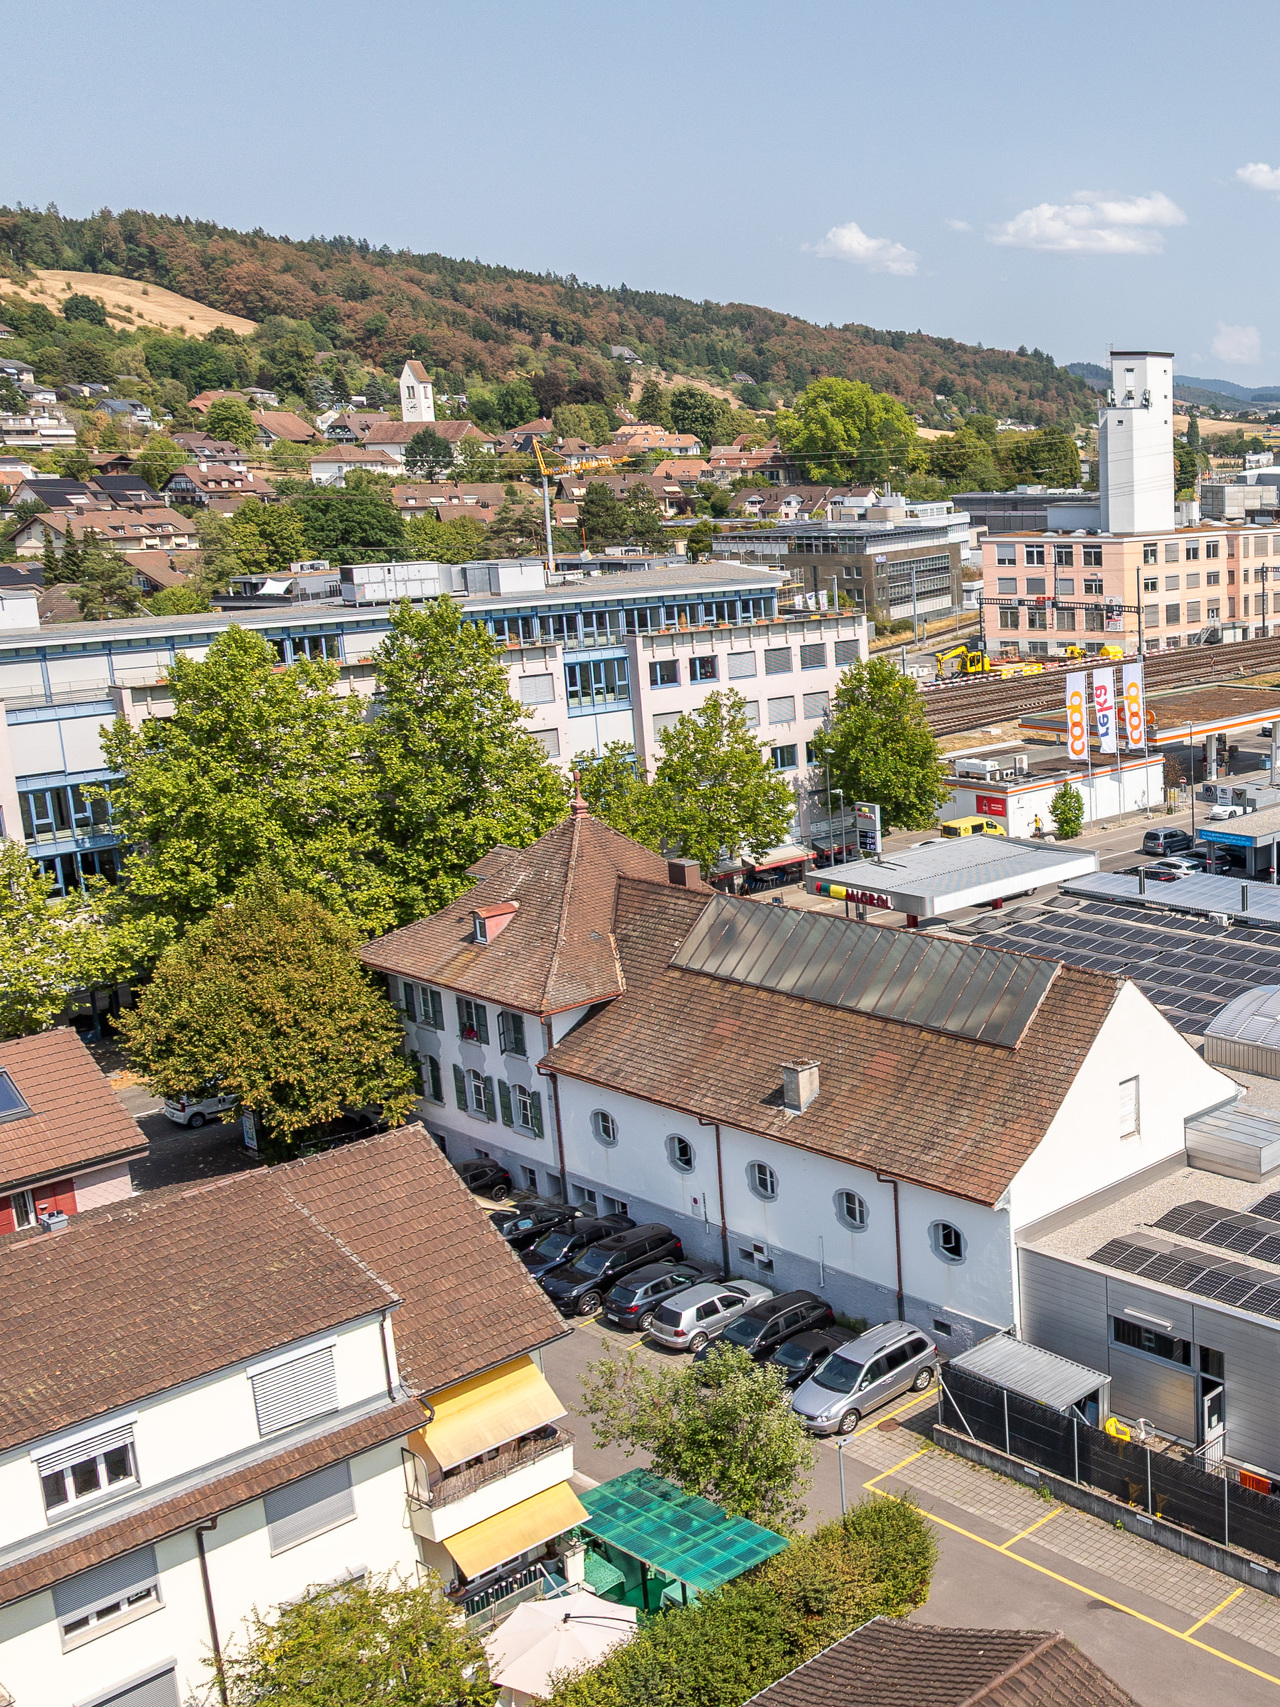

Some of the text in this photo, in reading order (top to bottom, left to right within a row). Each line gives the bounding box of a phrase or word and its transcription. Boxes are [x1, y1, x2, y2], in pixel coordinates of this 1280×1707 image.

[1066, 691, 1085, 756] coop
[1095, 685, 1113, 738] reka
[1124, 682, 1142, 745] coop
[846, 888, 893, 909] MIGROL
